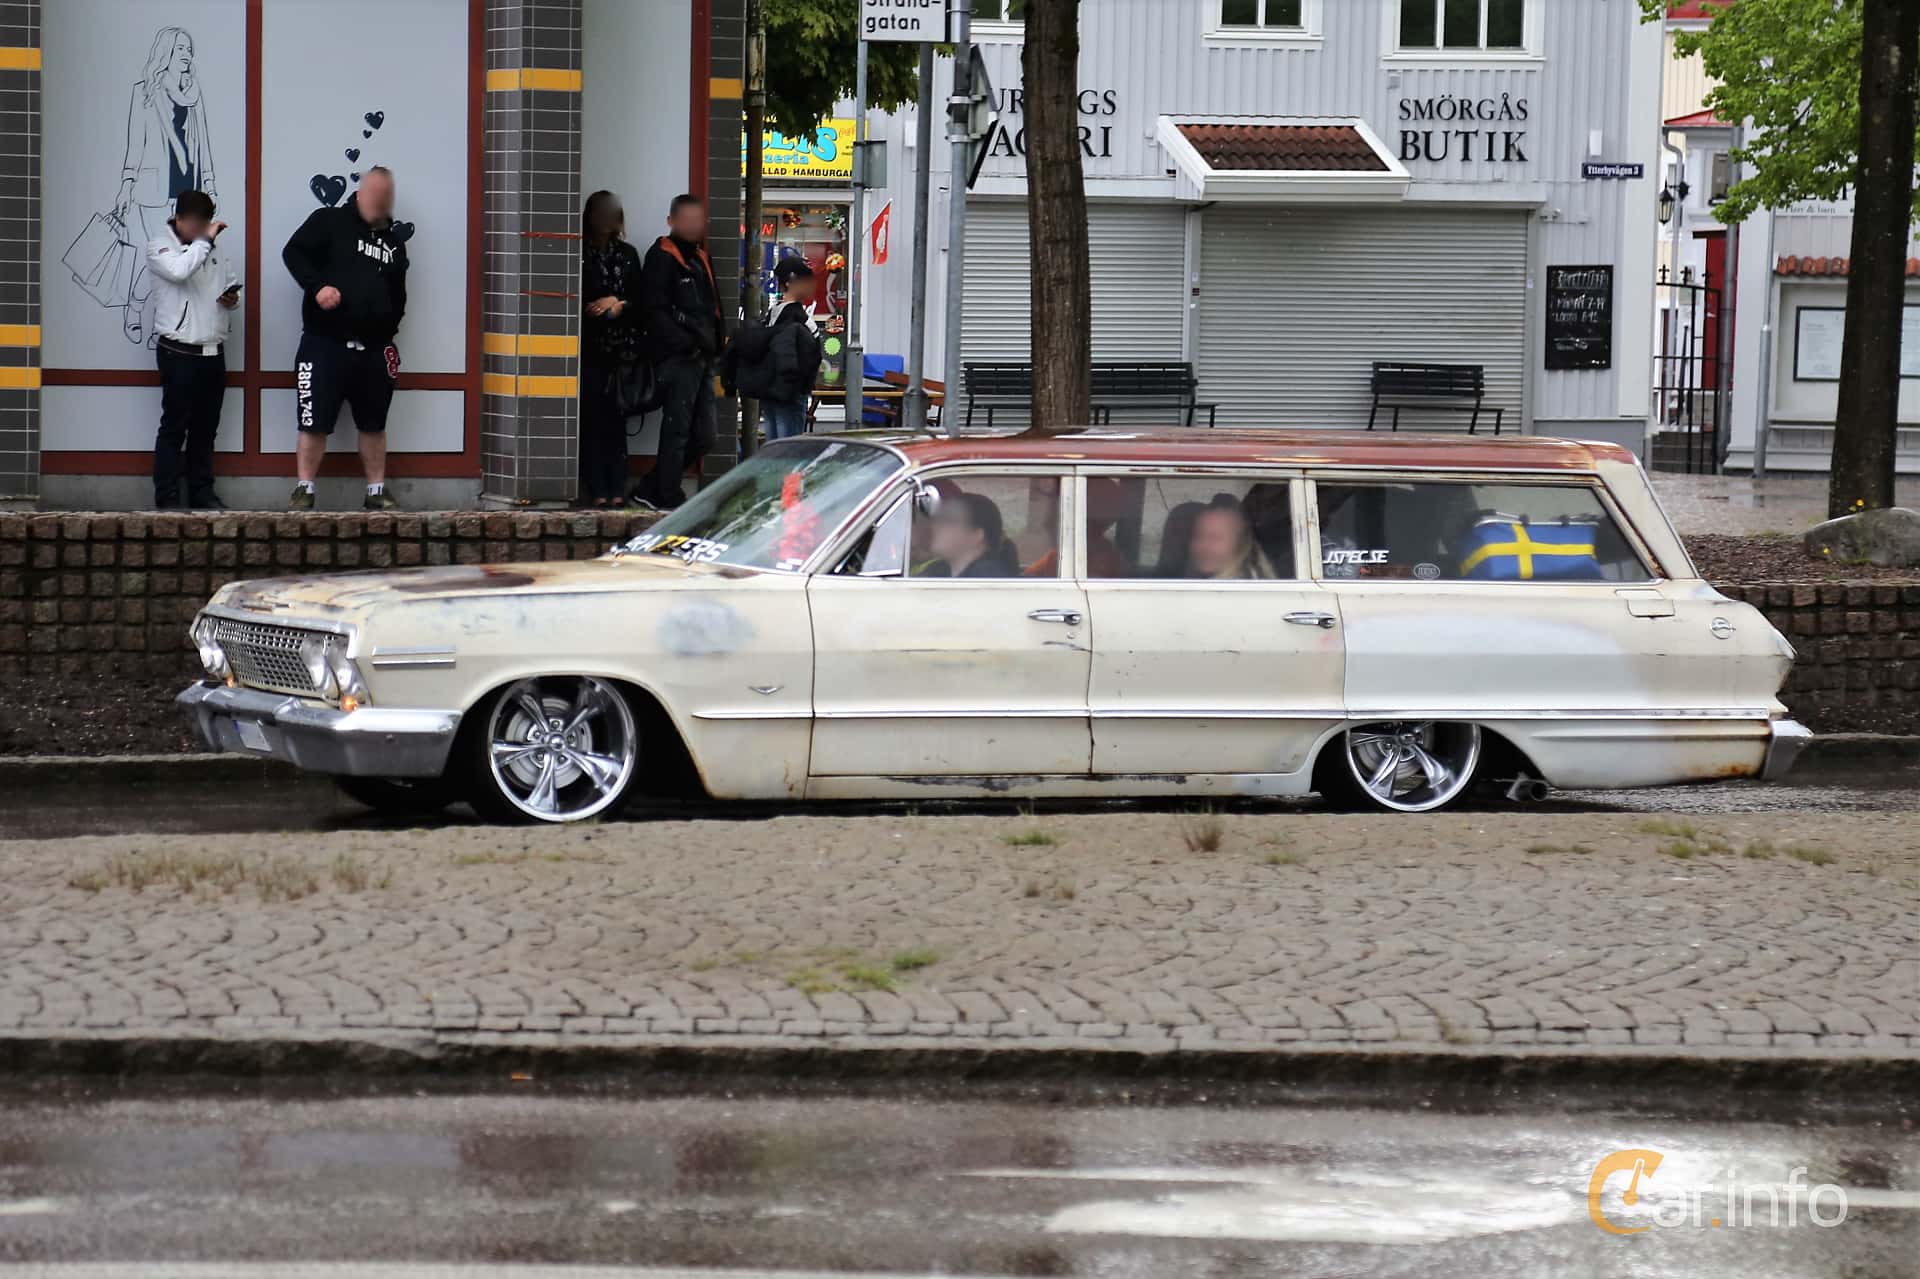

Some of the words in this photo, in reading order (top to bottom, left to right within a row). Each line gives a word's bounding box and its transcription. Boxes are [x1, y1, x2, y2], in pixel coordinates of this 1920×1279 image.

[866, 14, 920, 33] gatan
[1399, 92, 1528, 121] SMÖRGÅS
[1398, 129, 1529, 162] BUTIK
[357, 239, 389, 264] PUMA
